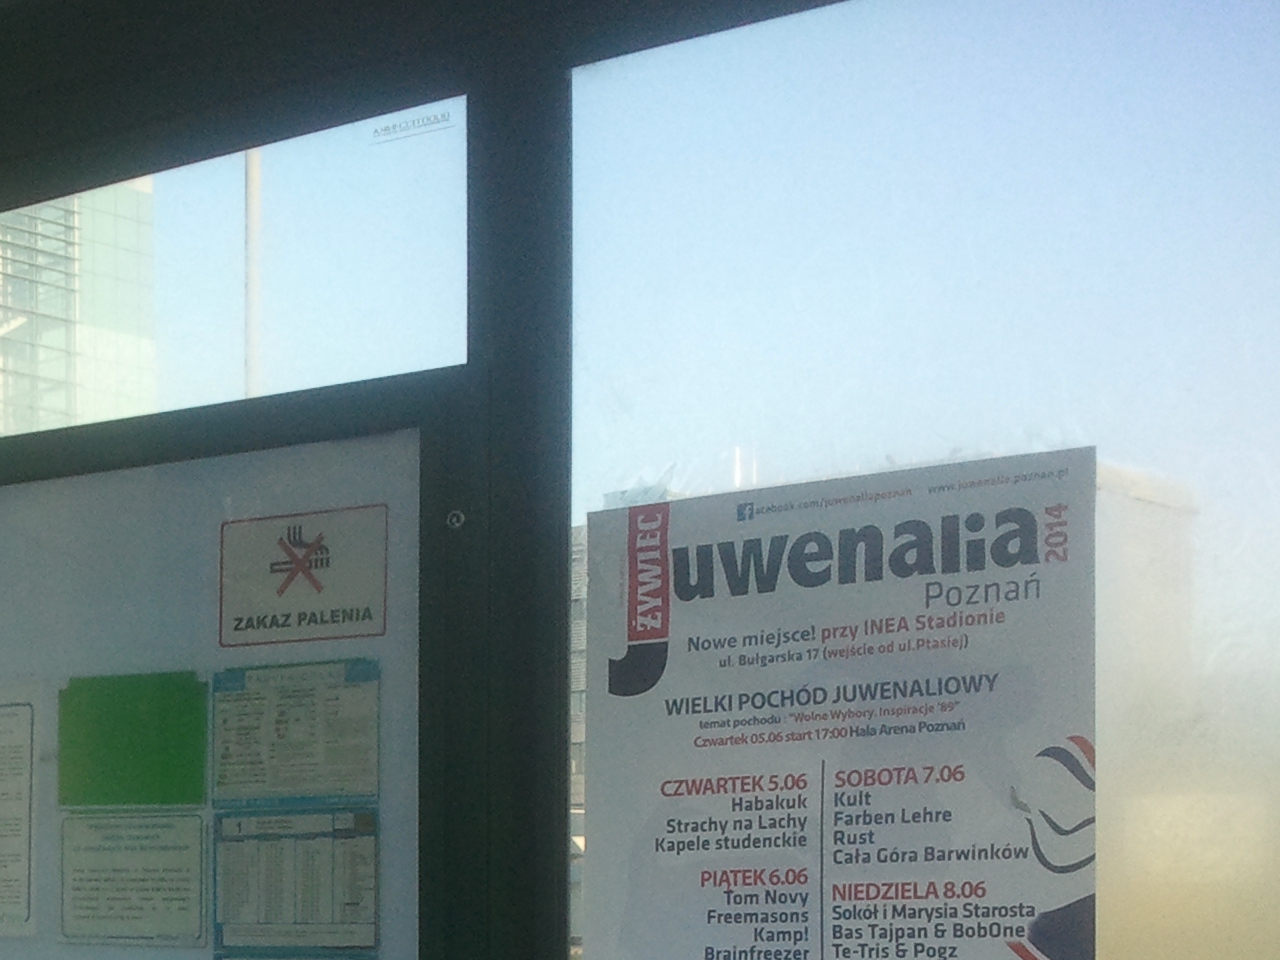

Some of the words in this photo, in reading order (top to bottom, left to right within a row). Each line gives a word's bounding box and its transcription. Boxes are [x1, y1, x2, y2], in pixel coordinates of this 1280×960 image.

[1044, 502, 1069, 563] 2014
[632, 512, 663, 632] ŻYWIEC
[924, 572, 1041, 608] Poznań
[233, 613, 291, 631] ZAKAZ
[297, 606, 374, 626] PALENIA
[687, 635, 737, 652] Nowe
[741, 625, 816, 649] miejsce!
[821, 622, 858, 643] przy
[864, 613, 910, 636] INEA
[915, 609, 1006, 631] Stadionie
[718, 654, 735, 668] ul.
[738, 649, 803, 668] Bułgarska
[806, 648, 819, 661] 17
[878, 641, 895, 654] od
[665, 693, 734, 716] WIELKI
[738, 684, 828, 711] POCHÓD
[831, 672, 1001, 705] JUWENALIOWY
[699, 717, 731, 730] temat
[732, 713, 782, 731] pochodu
[879, 702, 934, 720] Inspiracje
[693, 732, 749, 749] Czwartek
[750, 730, 783, 745] 05.06
[784, 728, 813, 743] start
[814, 726, 848, 740] 17:00
[849, 724, 877, 738] Hala
[878, 721, 916, 736] Arena
[918, 718, 966, 735] Poznań
[660, 774, 764, 798] CZWARTEK
[767, 773, 808, 793] 5.06
[834, 767, 919, 788] SOBOTA
[922, 764, 966, 784] 7.06
[731, 794, 808, 813] Habakuk
[833, 790, 872, 808] Kult
[235, 821, 242, 834] 1
[666, 815, 728, 836] Strachy
[732, 817, 753, 831] na
[758, 813, 808, 834] Lachy
[833, 810, 895, 827] Farben
[901, 807, 953, 824] Lehre
[655, 834, 710, 856] Kapele
[715, 831, 808, 851] studenckie
[833, 829, 875, 846] Rust
[833, 848, 871, 866] Cała
[876, 845, 918, 864] Góra
[923, 842, 1030, 863] Barwinków
[700, 869, 766, 891] PIĄTEK
[768, 867, 809, 886] 6.06
[832, 881, 938, 901] NIEDZIELA
[942, 880, 987, 899] 8.06
[723, 889, 759, 906] Tom
[765, 889, 809, 908] Novy
[706, 908, 809, 925] Freemasons
[832, 903, 880, 921] Sokół
[891, 903, 958, 923] Marysia
[962, 902, 1036, 919] Starosta
[753, 926, 809, 947] Kamp!
[832, 924, 863, 940] Bas
[868, 923, 928, 943] Tajpan
[933, 922, 948, 939] &
[952, 922, 1026, 939] BobOne
[832, 943, 890, 960] Te-Tris
[895, 943, 909, 959] &
